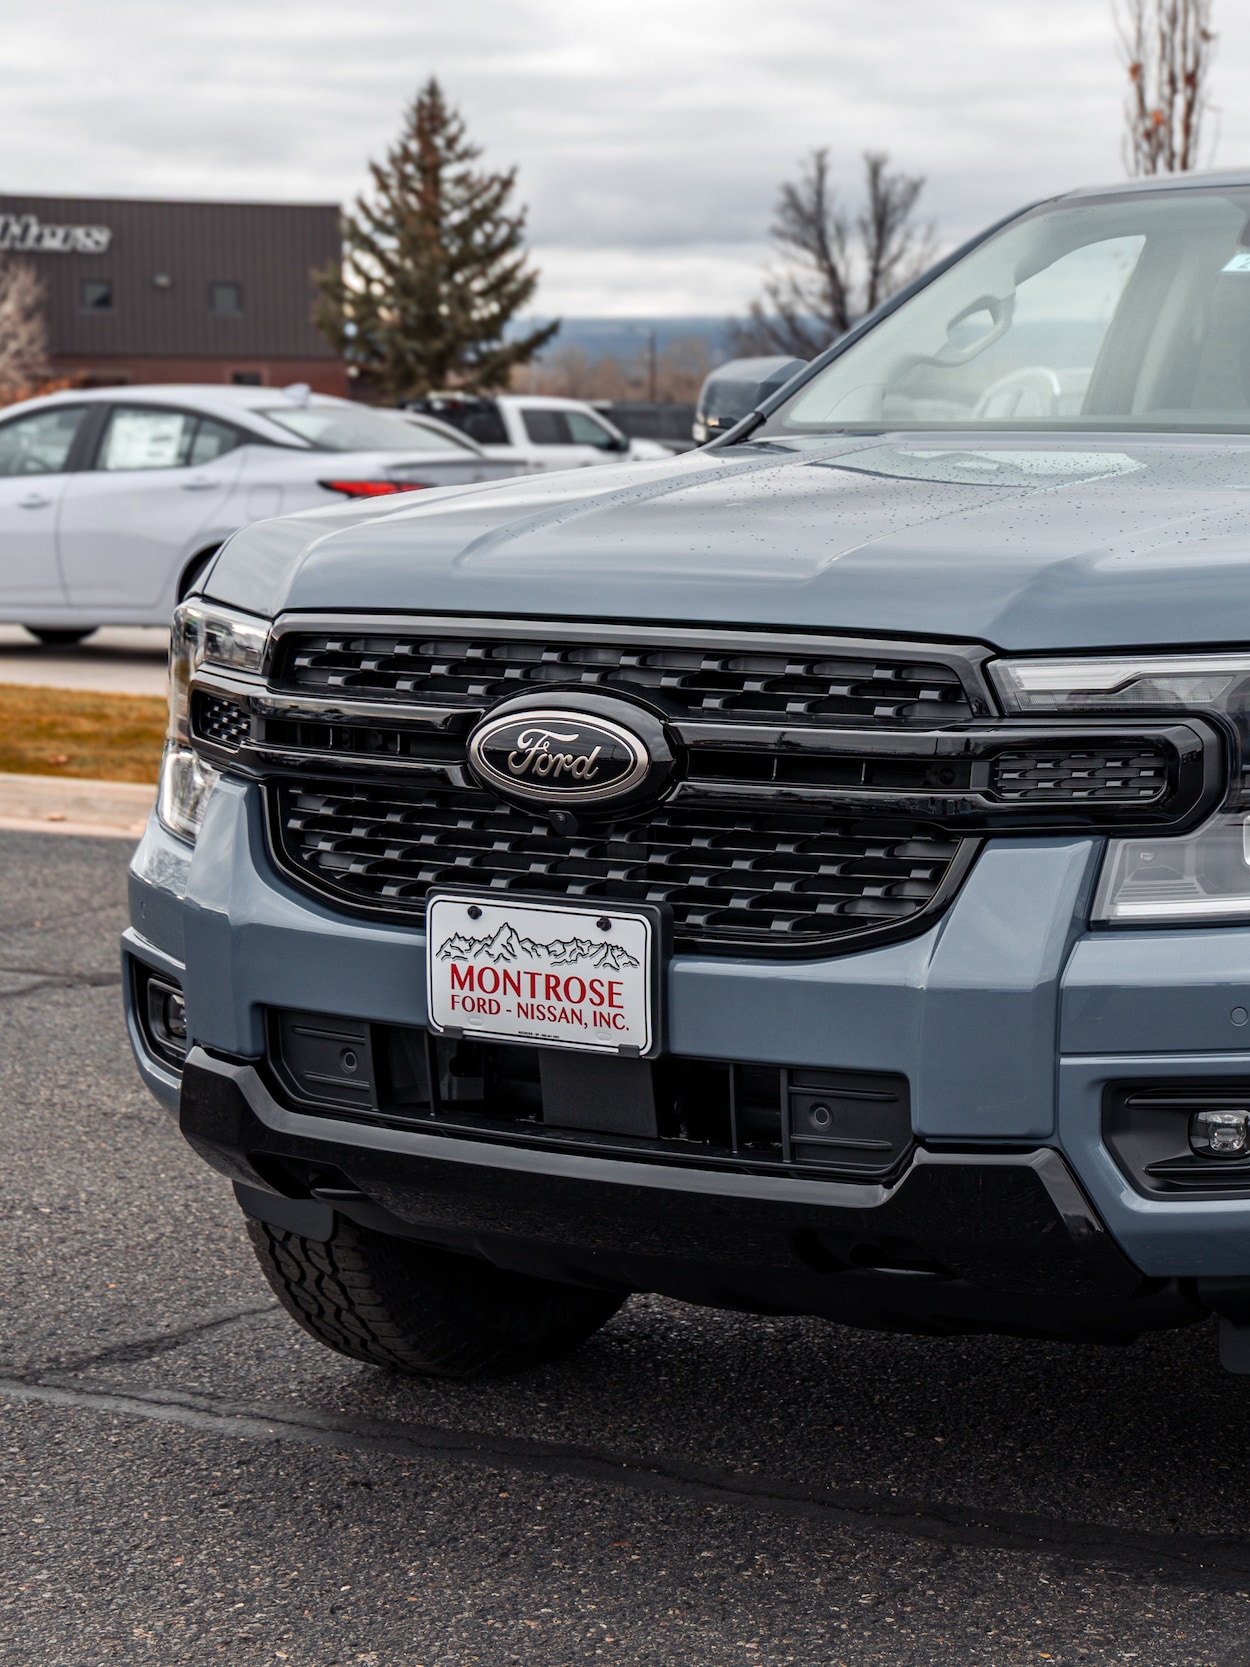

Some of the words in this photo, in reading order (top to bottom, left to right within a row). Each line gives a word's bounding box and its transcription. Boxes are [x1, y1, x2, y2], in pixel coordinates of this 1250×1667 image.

[507, 728, 602, 780] Ford
[450, 963, 624, 1009] MONTROSE
[451, 994, 501, 1015] FORD
[517, 1002, 588, 1029] NISSAN,
[593, 1010, 630, 1031] INC.
